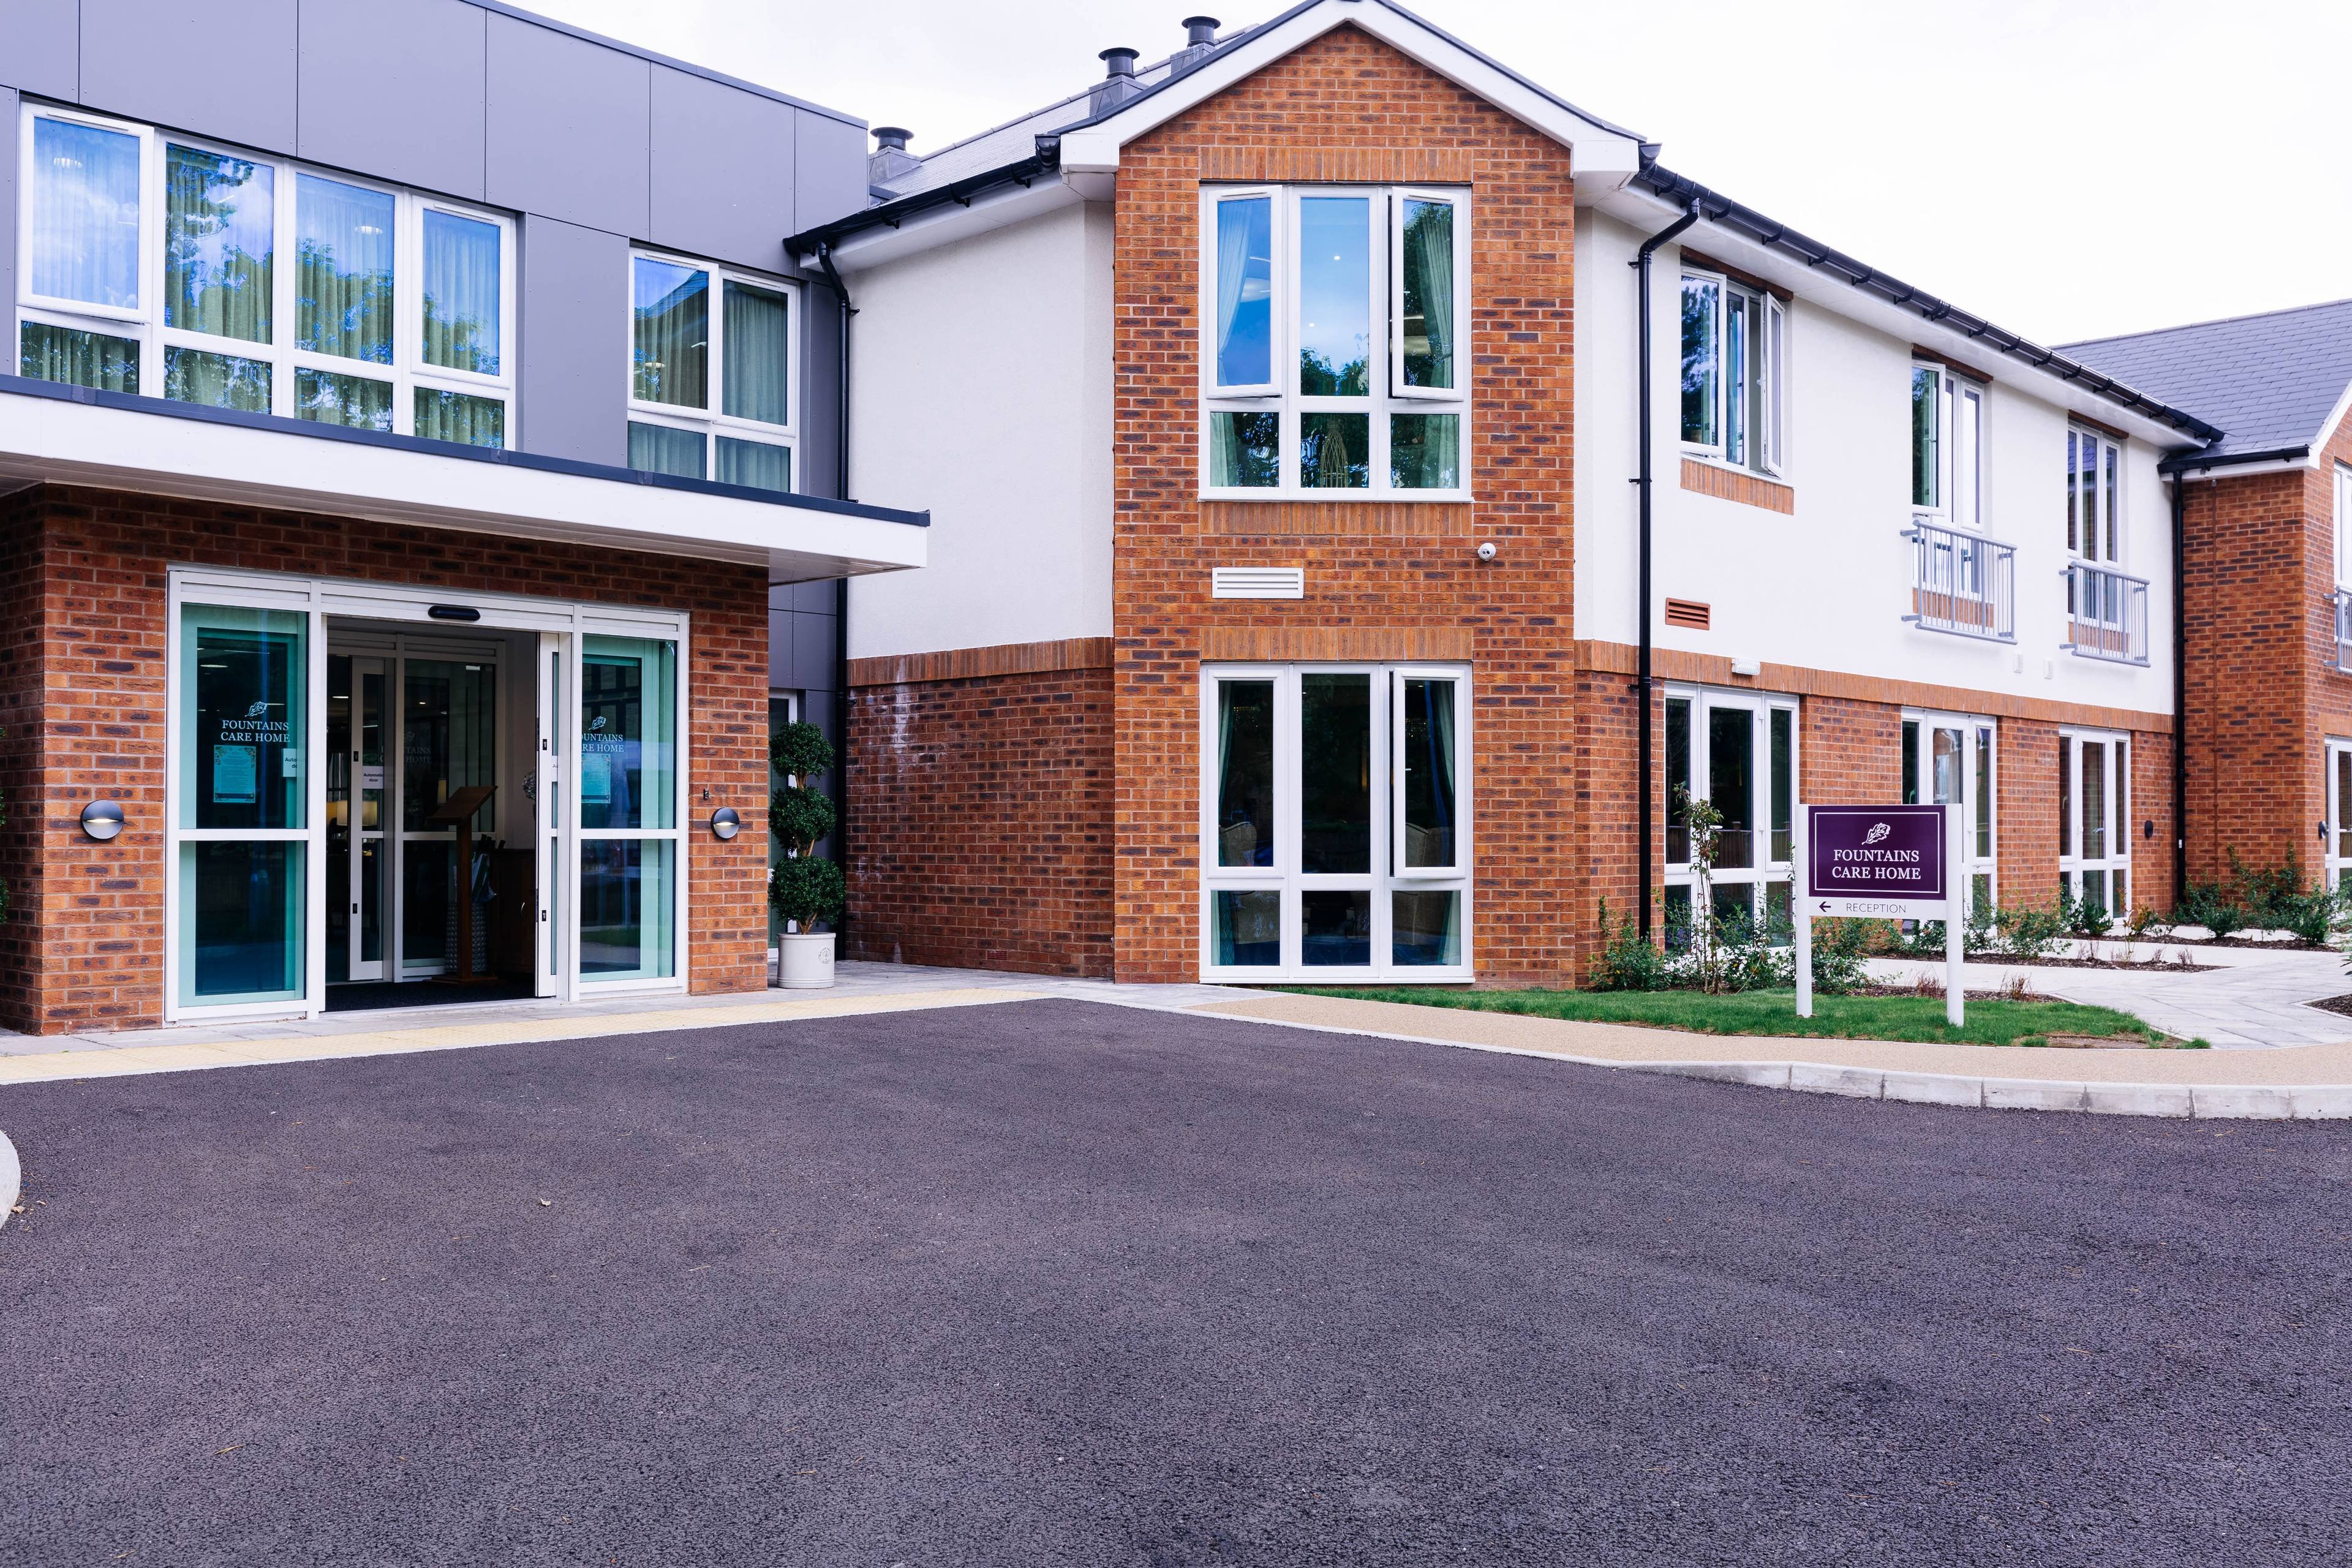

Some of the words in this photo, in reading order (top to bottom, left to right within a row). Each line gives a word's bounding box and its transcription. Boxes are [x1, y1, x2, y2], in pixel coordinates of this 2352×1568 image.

[222, 720, 289, 731] FOUNTAINS
[221, 731, 252, 742] CARE
[255, 733, 290, 742] HOME
[581, 733, 623, 742] UNTAINS
[597, 744, 624, 753] HOME
[1833, 849, 1920, 862] FOUNTAINS
[1831, 866, 1871, 879] CARE
[1874, 867, 1921, 880] HOME
[1845, 902, 1906, 913] RECEPTION
